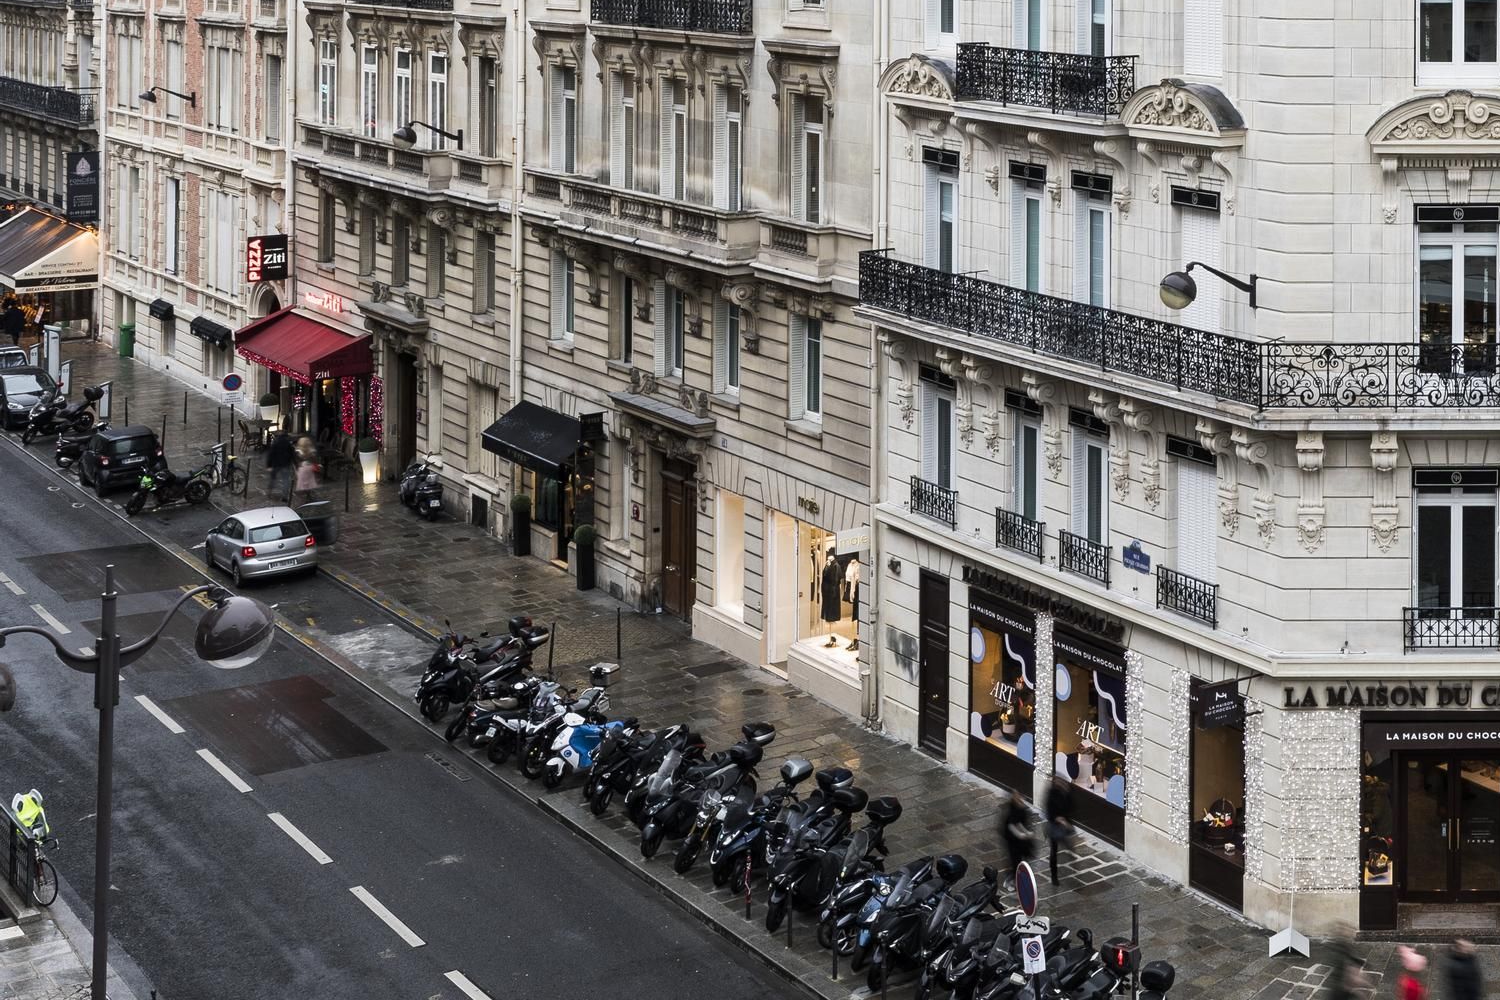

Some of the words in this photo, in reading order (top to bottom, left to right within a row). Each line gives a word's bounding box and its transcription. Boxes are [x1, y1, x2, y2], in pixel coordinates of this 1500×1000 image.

[249, 239, 261, 281] PIZZA
[263, 252, 286, 265] Ziti
[323, 293, 343, 313] Ziti
[840, 535, 869, 546] maje
[969, 602, 976, 611] LA
[977, 606, 996, 619] MAISON
[996, 614, 1004, 622] DU
[1004, 618, 1032, 634] CHOCOLAT
[1053, 640, 1060, 648] LA
[1061, 643, 1082, 656] MAISON
[1083, 652, 1091, 660] DU
[1092, 656, 1123, 672] CHOCOLAT
[989, 681, 1016, 704] ART
[1284, 686, 1318, 707] LA
[1326, 686, 1429, 707] MAISON
[1437, 686, 1472, 706] DU
[1075, 720, 1105, 744] ART
[1386, 732, 1399, 740] LA
[1402, 732, 1445, 740] MAISON
[1448, 732, 1463, 740] DU
